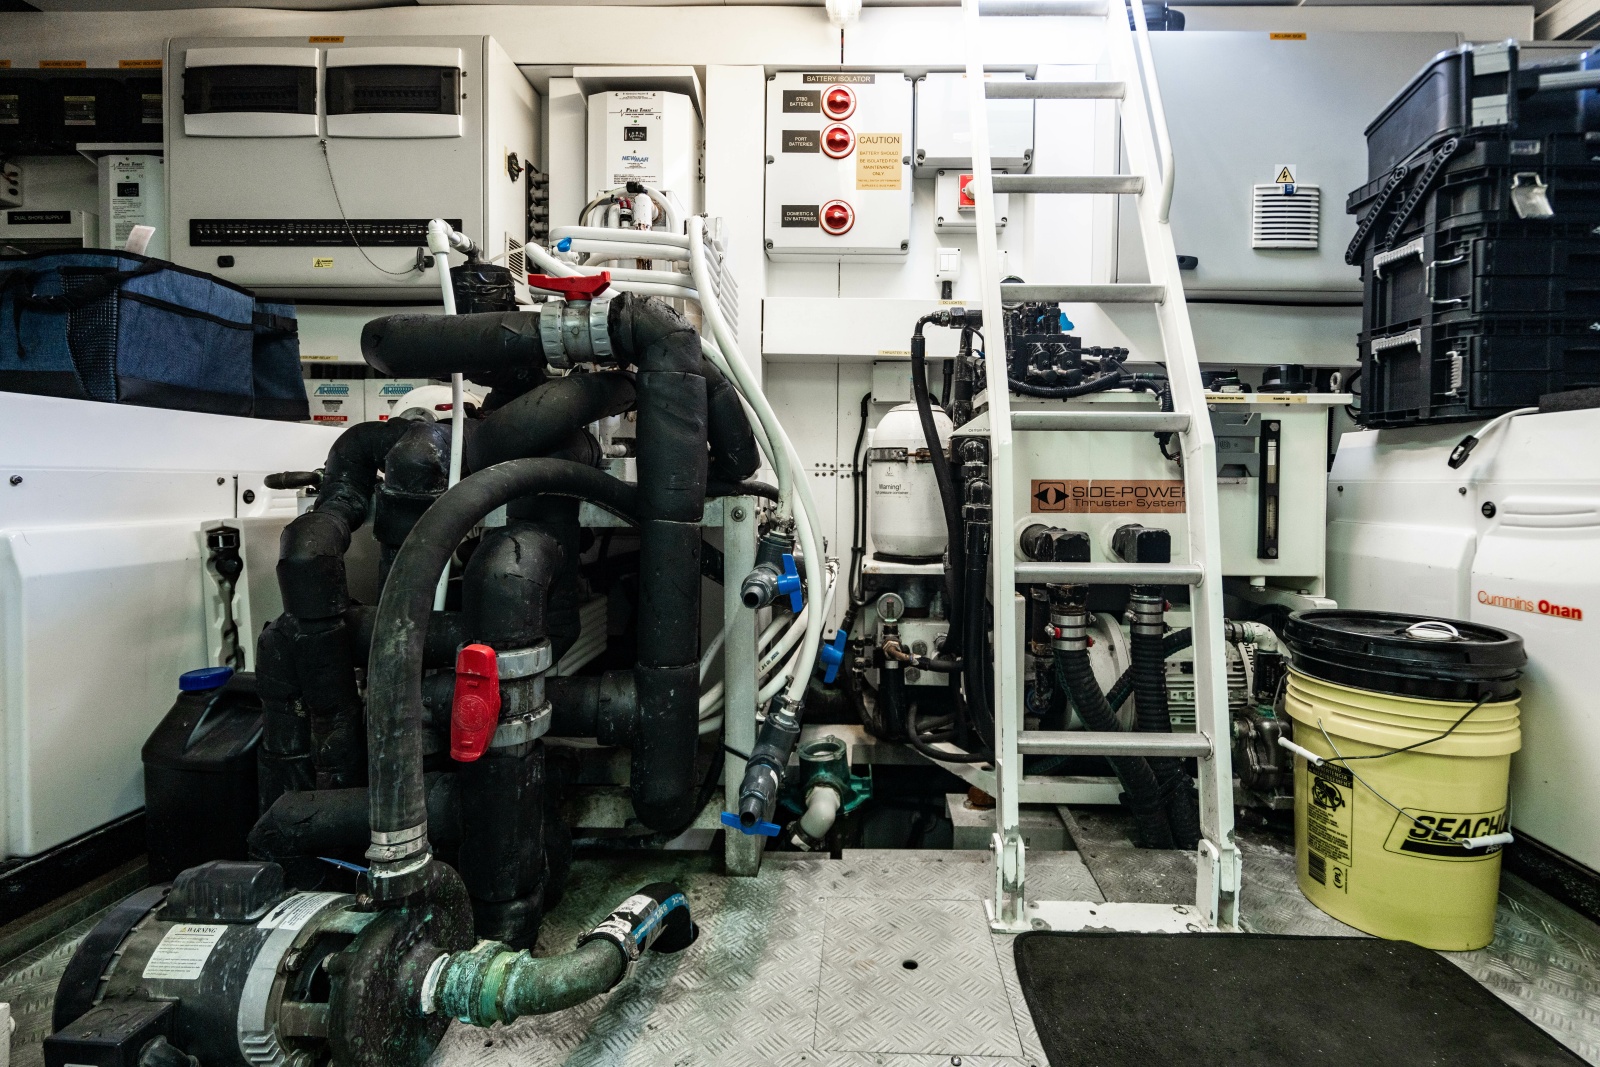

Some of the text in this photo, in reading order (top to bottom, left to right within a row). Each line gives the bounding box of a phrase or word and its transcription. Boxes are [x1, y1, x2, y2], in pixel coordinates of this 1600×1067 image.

[859, 136, 900, 144] CAUTION
[878, 483, 902, 491] Warning!
[1072, 498, 1186, 509] Thruster System
[1477, 590, 1583, 620] Cummins Onan
[1242, 641, 1255, 673] CAUTIO
[1408, 815, 1506, 842] SEACH
